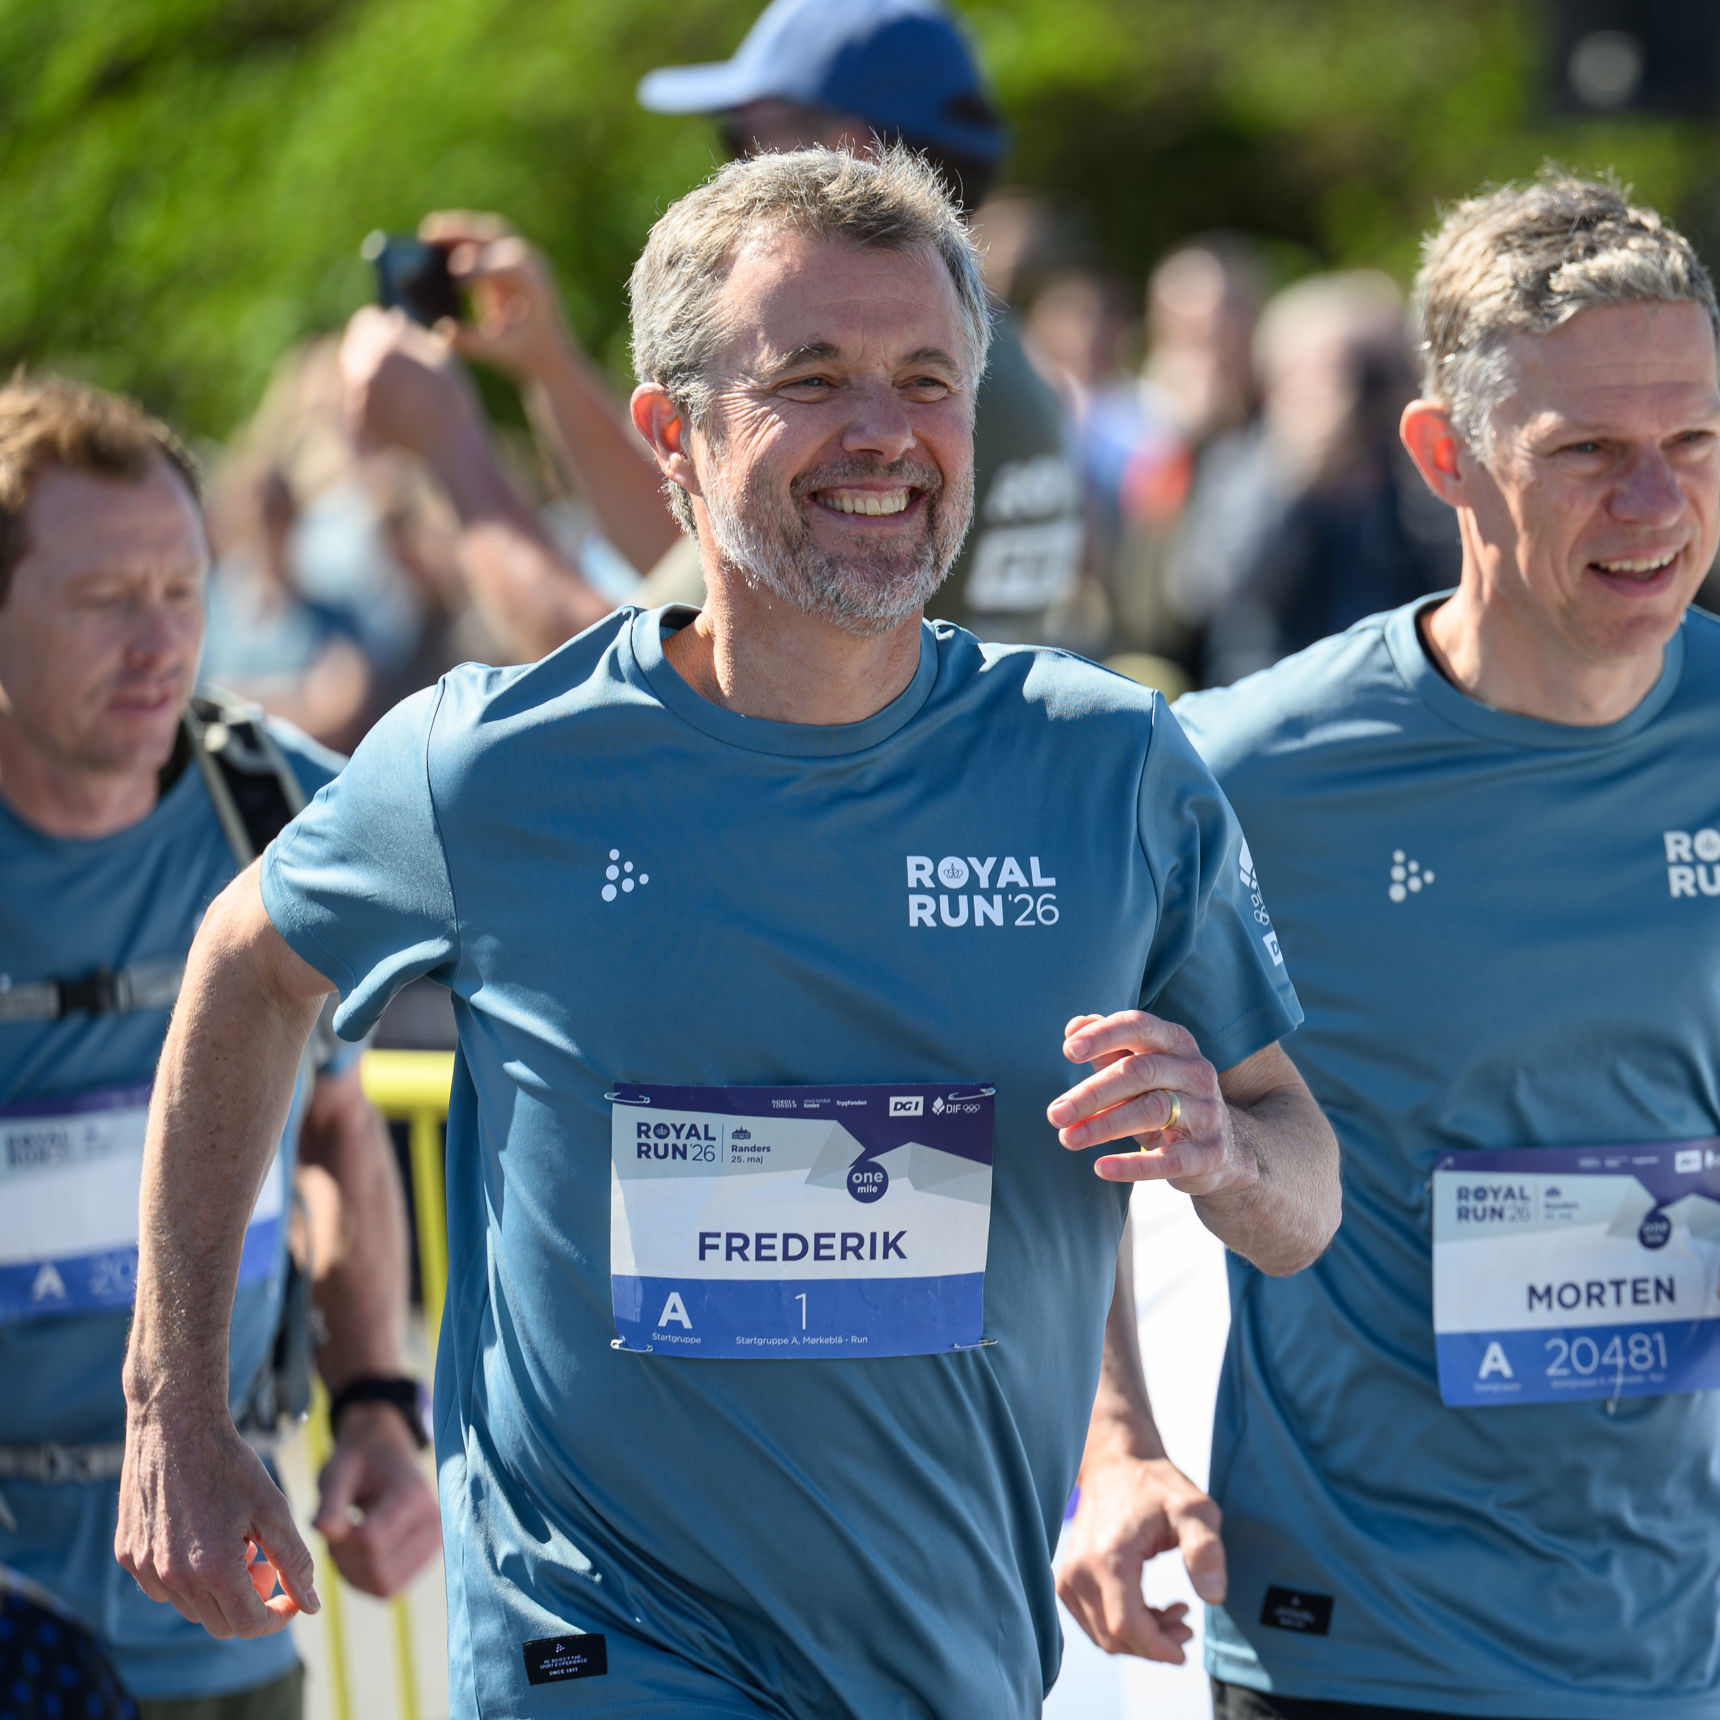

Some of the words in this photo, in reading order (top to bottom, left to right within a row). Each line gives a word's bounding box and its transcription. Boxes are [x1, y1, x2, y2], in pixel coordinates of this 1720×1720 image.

[1663, 828, 1720, 863] RO
[906, 855, 1056, 889] ROYAL
[1668, 863, 1720, 898] RU
[893, 1101, 920, 1111] DGI
[946, 1104, 961, 1114] DIF
[636, 1122, 716, 1141] ROYAL
[731, 1144, 771, 1153] Randers
[731, 1155, 745, 1163] 25.
[747, 1154, 763, 1164] maj
[852, 1171, 884, 1184] one
[857, 1184, 878, 1194] mile
[1457, 1185, 1530, 1202] ROYAL
[698, 1230, 908, 1262] FREDERIK
[1527, 1275, 1677, 1311] MORTEN
[657, 1292, 693, 1329] A
[795, 1292, 807, 1331] 1
[652, 1332, 702, 1345] Startgruppe
[735, 1336, 789, 1346] Startgruppe
[803, 1335, 843, 1345] Mørkeblå
[851, 1335, 868, 1344] Run
[1478, 1341, 1514, 1379] A
[1544, 1332, 1668, 1376] 20481
